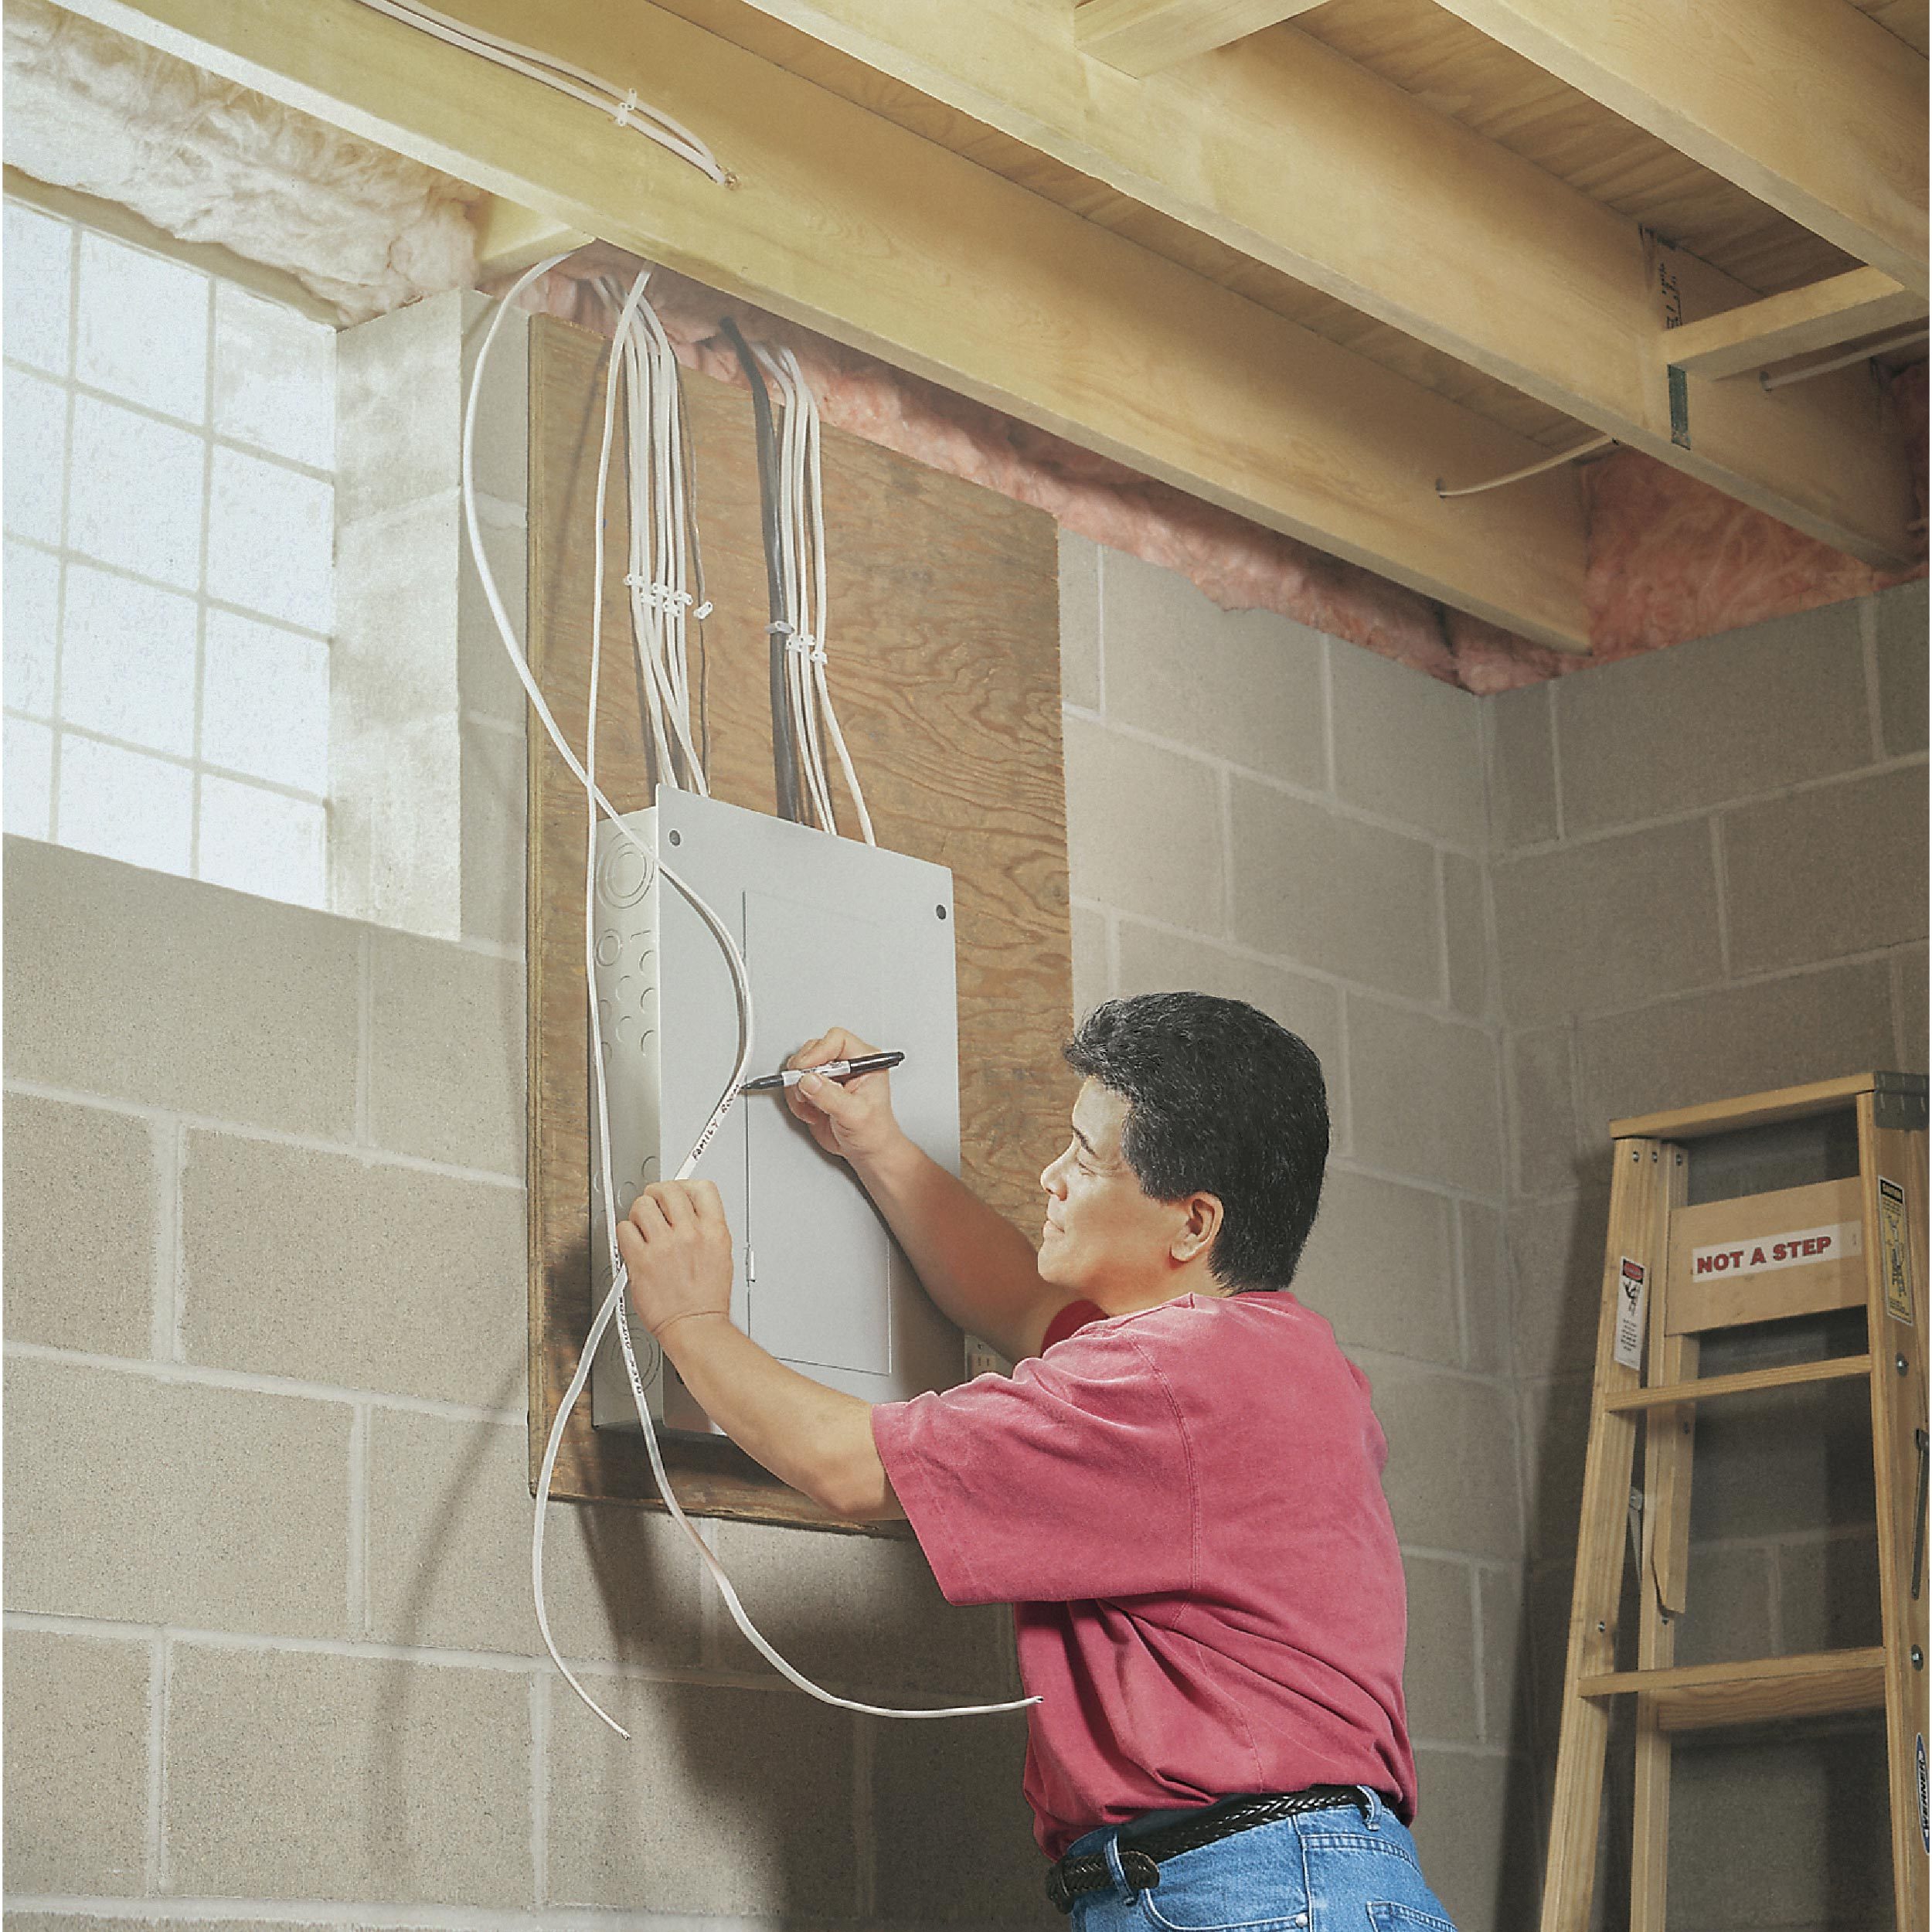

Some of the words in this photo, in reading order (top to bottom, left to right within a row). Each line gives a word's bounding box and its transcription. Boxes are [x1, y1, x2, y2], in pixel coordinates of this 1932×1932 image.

[1697, 1250, 1744, 1274] NOT
[1750, 1247, 1767, 1266] A
[1773, 1236, 1832, 1261] STEP
